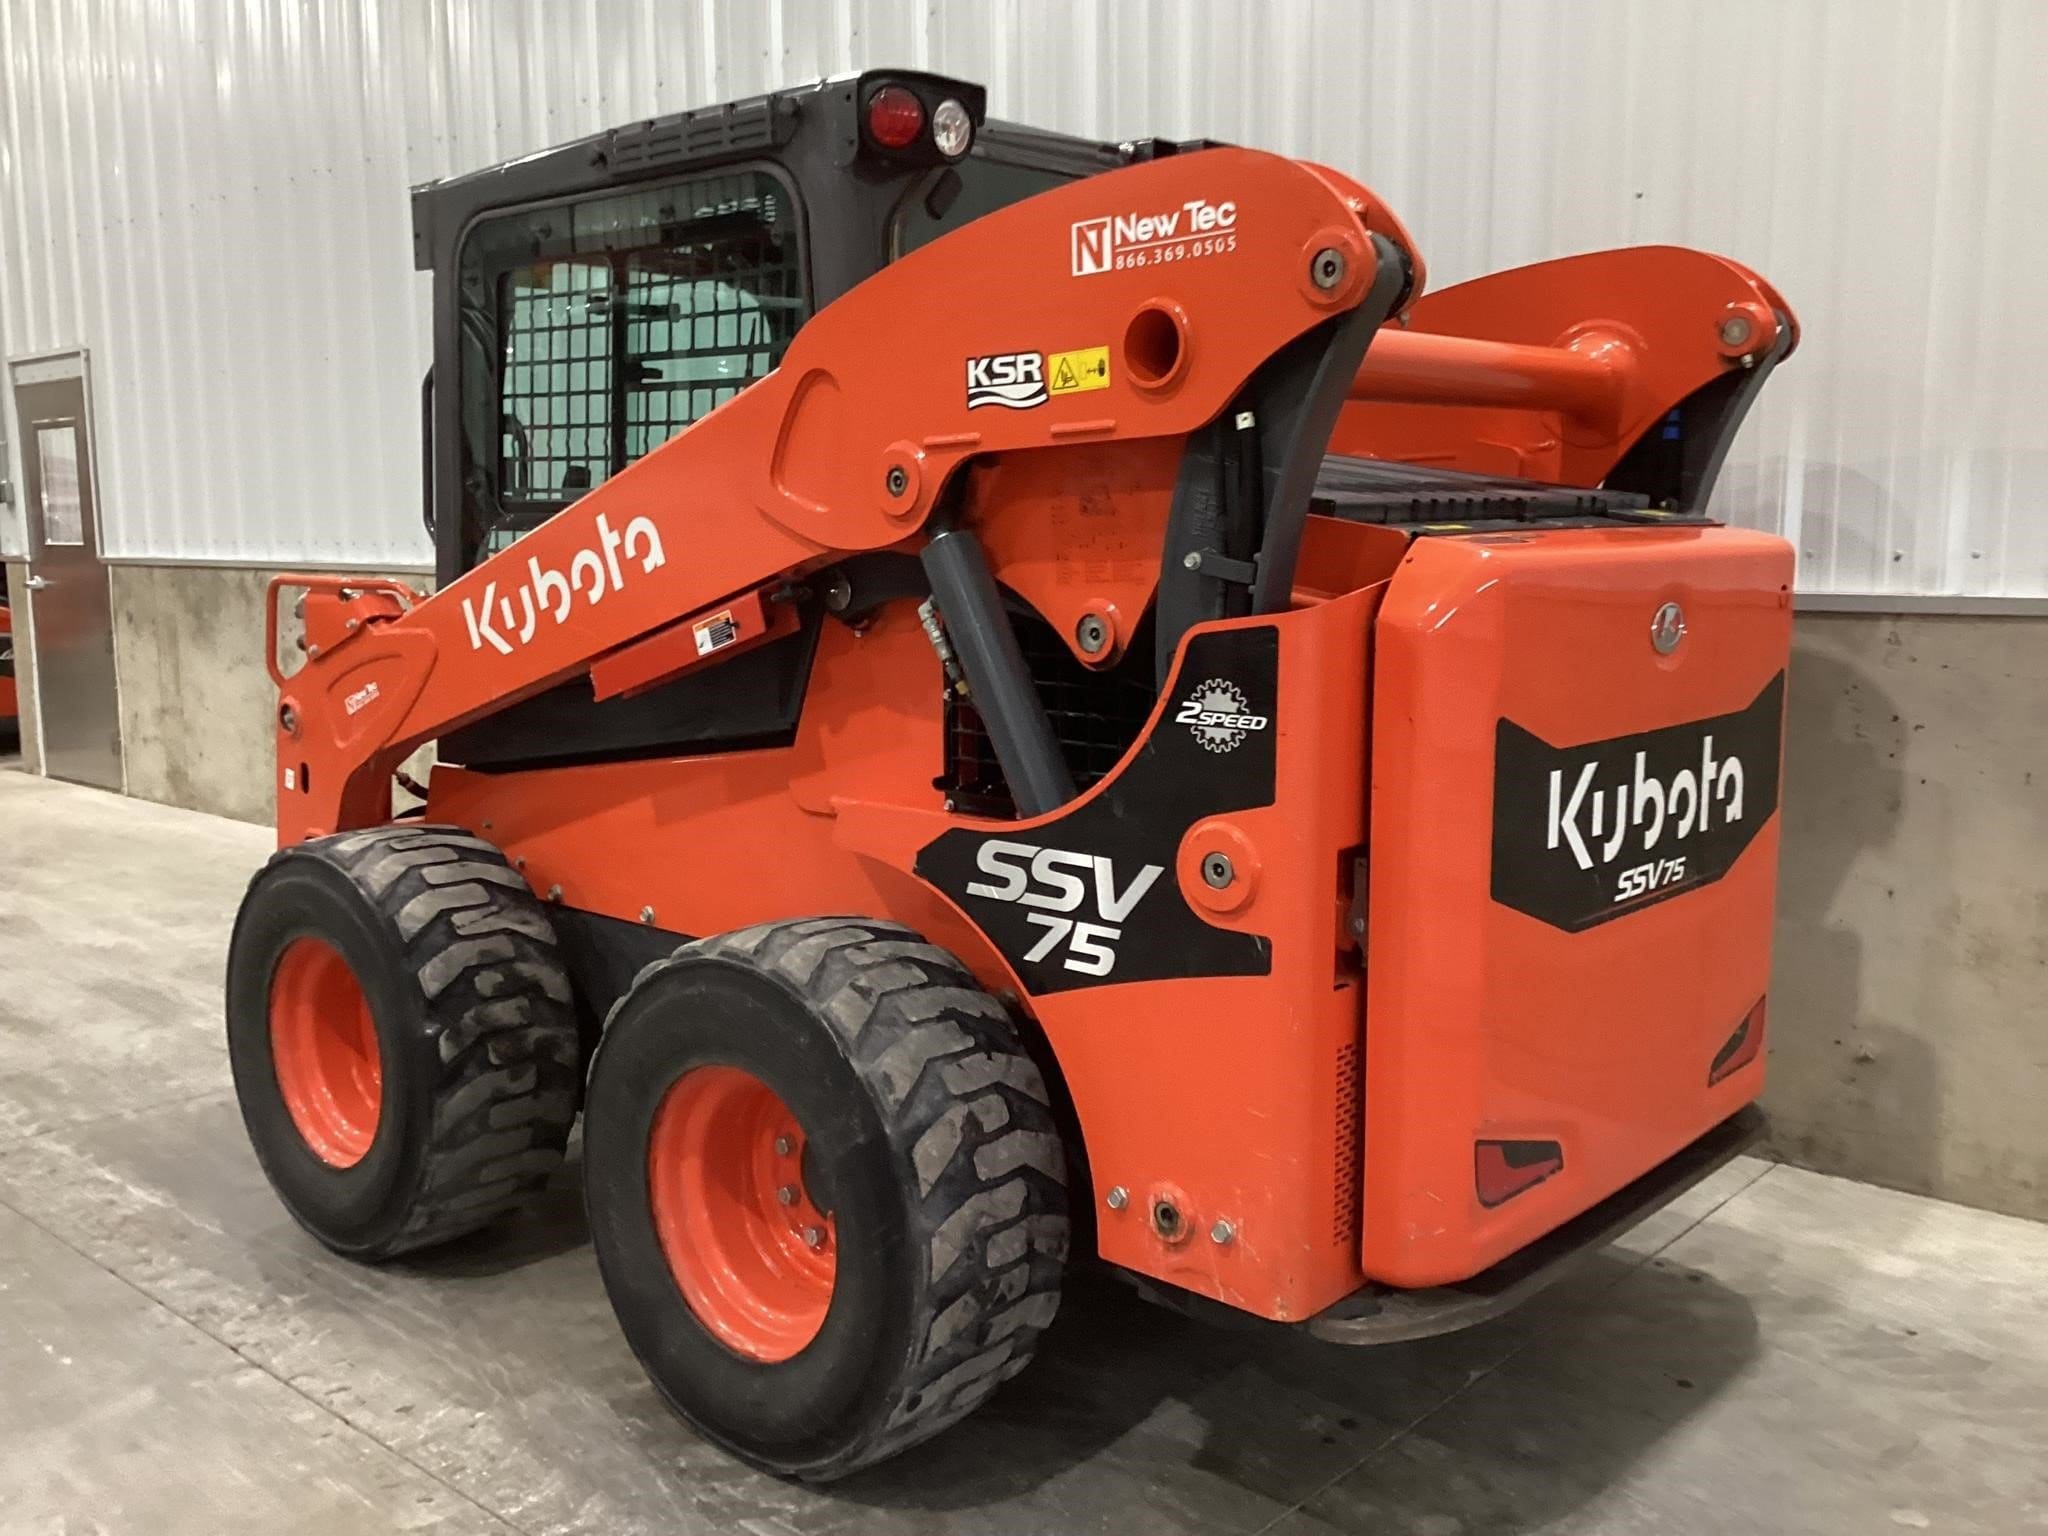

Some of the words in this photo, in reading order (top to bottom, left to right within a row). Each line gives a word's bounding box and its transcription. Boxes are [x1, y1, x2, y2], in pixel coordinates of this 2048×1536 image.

[1115, 212, 1180, 245] New
[1183, 200, 1237, 232] Tec
[1115, 235, 1237, 270] 866.369.0505
[967, 352, 1043, 387] KSR
[461, 512, 666, 655] Kubota
[1547, 735, 1744, 870] Kubota
[966, 839, 1165, 923] SSV
[1023, 912, 1122, 977] 75
